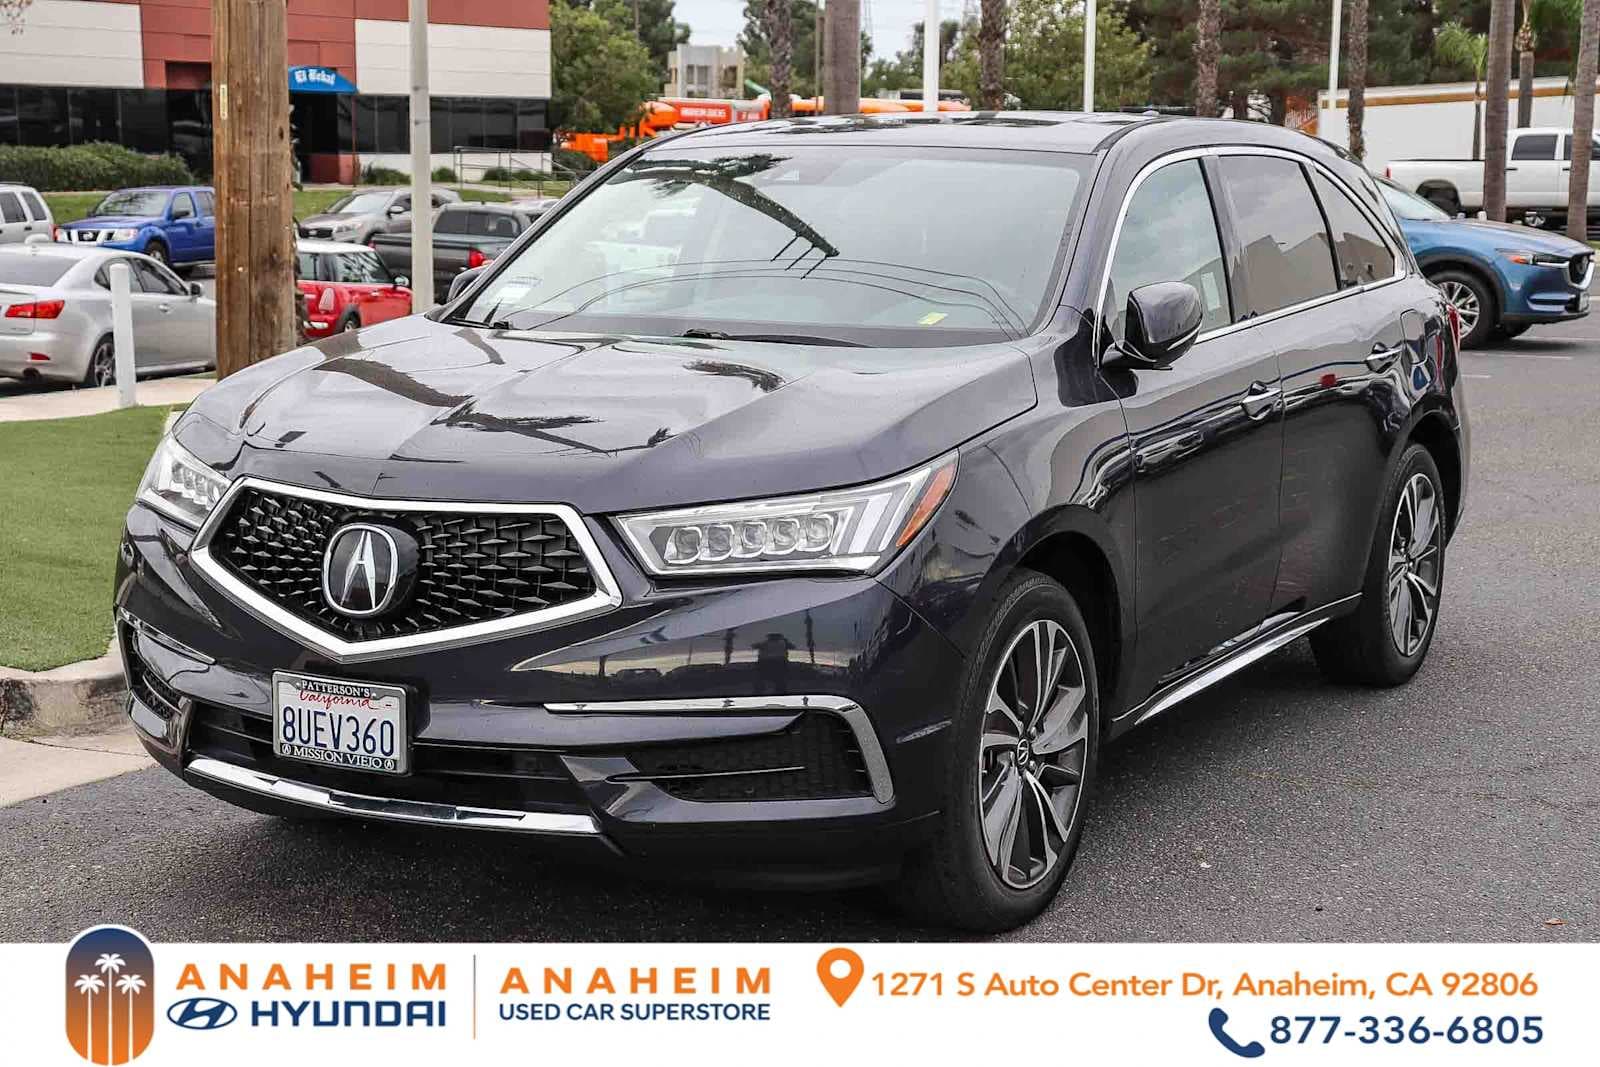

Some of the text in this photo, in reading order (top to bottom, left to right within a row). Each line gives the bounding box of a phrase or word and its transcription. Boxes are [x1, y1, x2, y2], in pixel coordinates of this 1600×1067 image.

[301, 680, 371, 697] PATTERSON'S
[283, 706, 394, 757] 8UEV360
[294, 747, 382, 769] MISSION VIEJO
